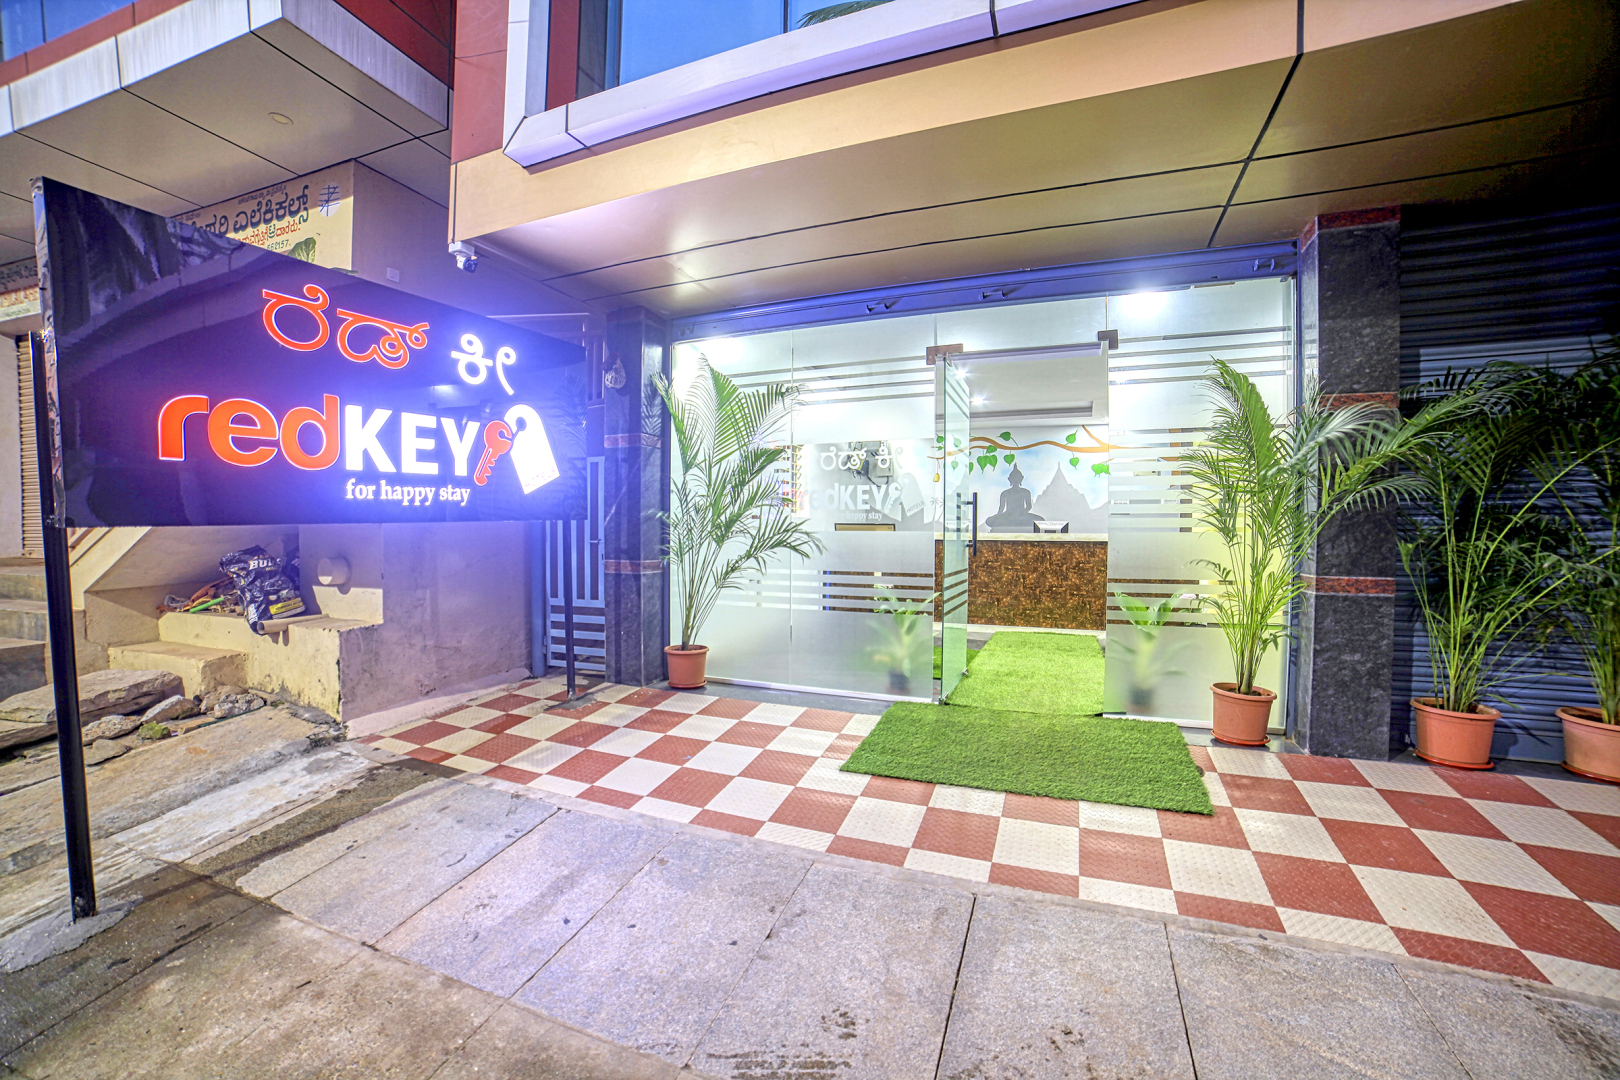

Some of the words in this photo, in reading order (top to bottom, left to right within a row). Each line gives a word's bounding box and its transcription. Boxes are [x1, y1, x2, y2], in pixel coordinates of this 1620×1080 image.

[262, 283, 430, 370] ರೆಡ್
[450, 333, 517, 396] ಕೀ
[157, 393, 481, 477] redKEY
[346, 478, 376, 500] for
[380, 480, 435, 505] happy
[439, 484, 471, 506] stay
[868, 511, 884, 521] stay
